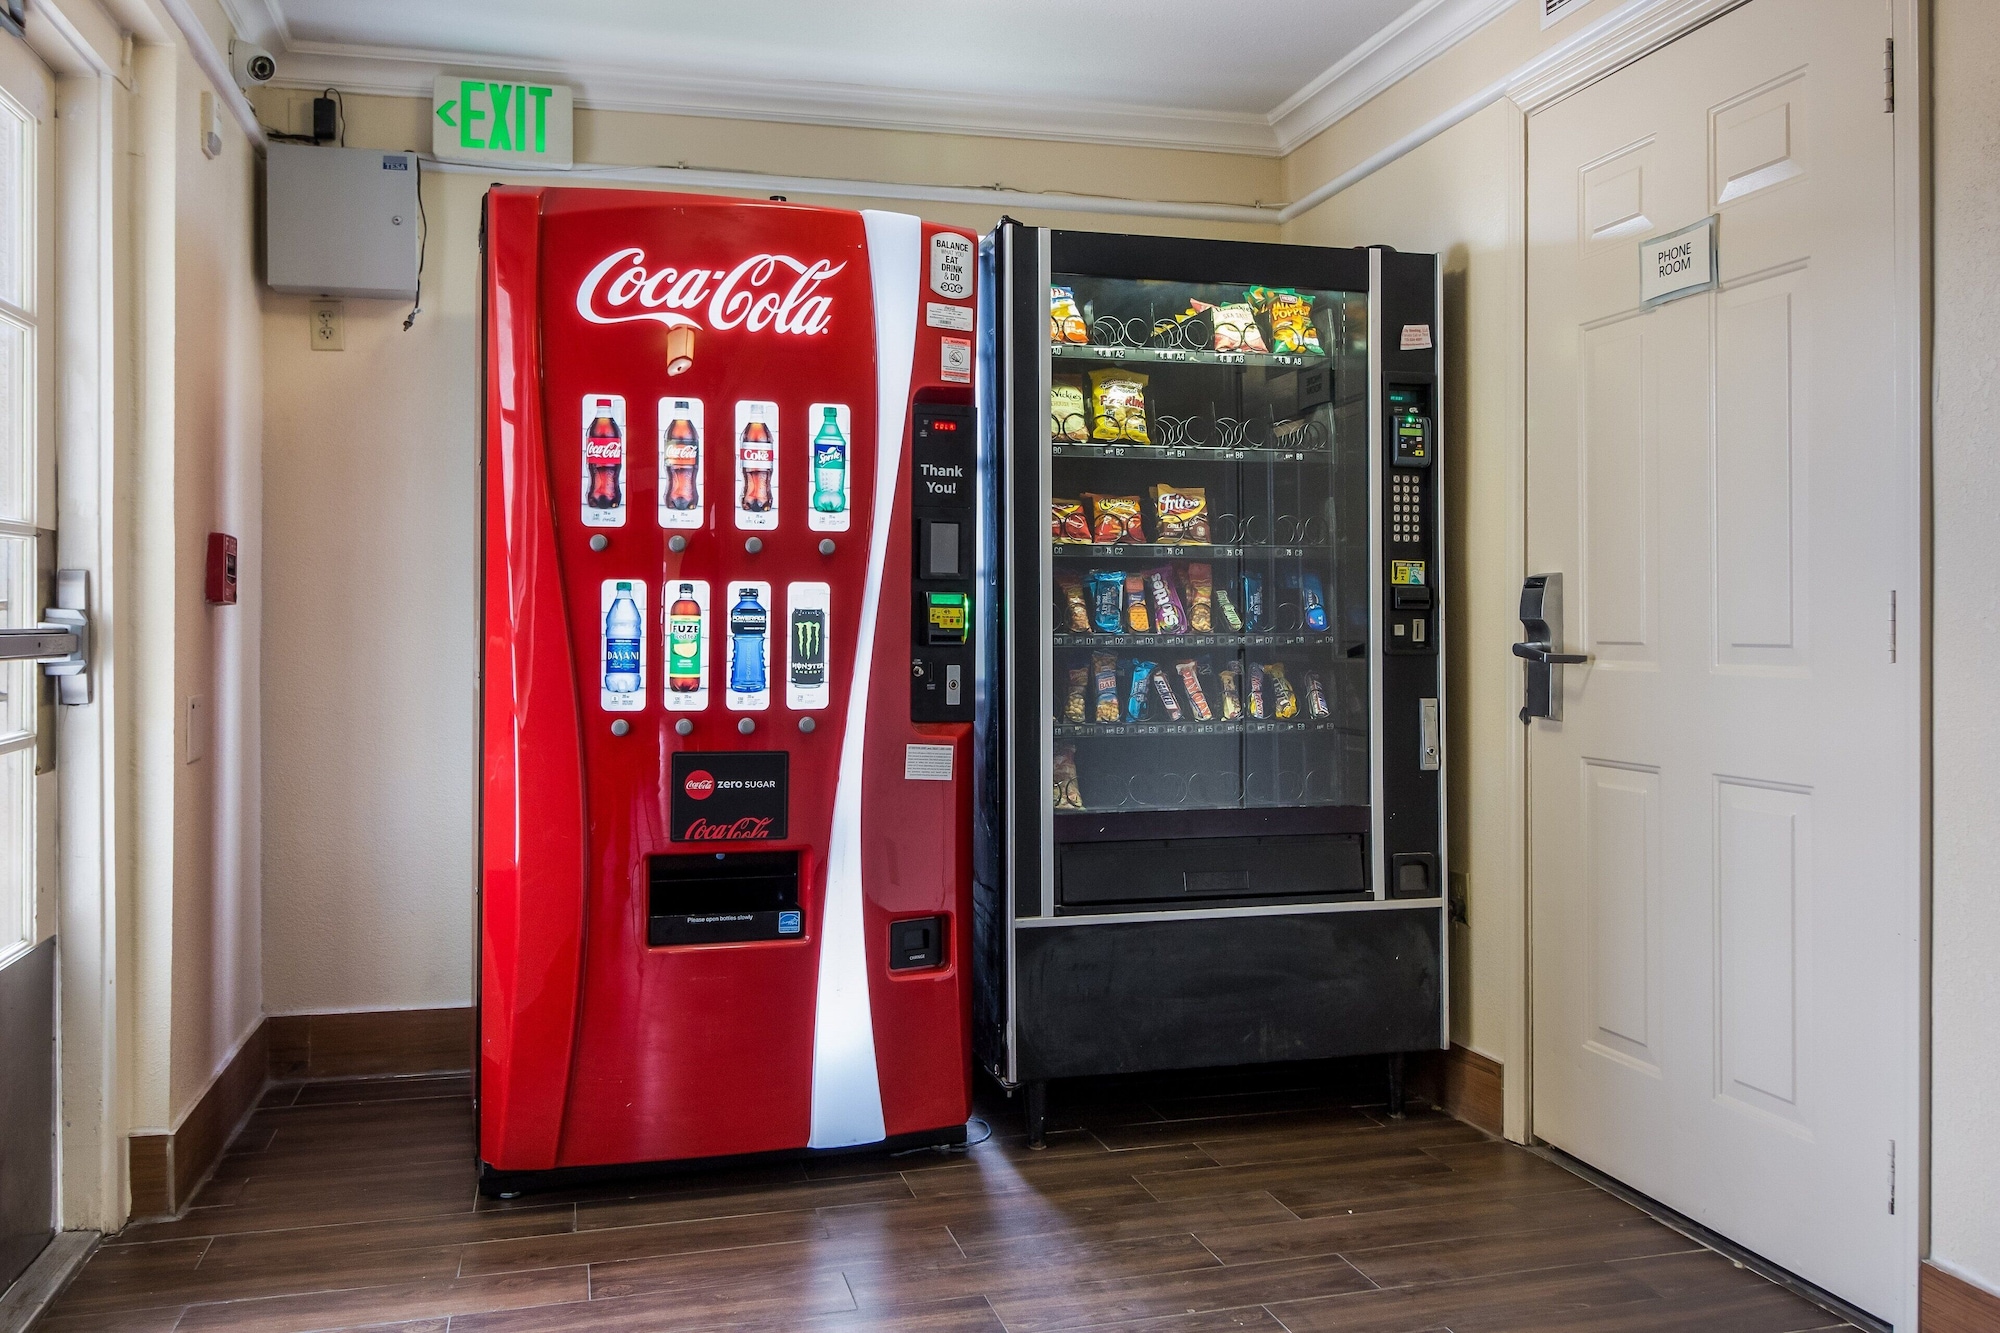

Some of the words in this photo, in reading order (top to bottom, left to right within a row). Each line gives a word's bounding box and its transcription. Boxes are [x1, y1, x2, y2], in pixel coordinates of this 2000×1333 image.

[460, 81, 552, 153] EXIT
[384, 163, 407, 171] TESA
[936, 239, 969, 252] BALANCE
[1658, 242, 1692, 264] PHONE
[945, 256, 958, 265] EAT
[941, 263, 963, 274] DRINK
[1659, 257, 1691, 278] ROOM
[943, 273, 949, 281] &
[950, 273, 960, 282] DO
[576, 247, 847, 336] Coca-Cola
[1052, 347, 1062, 355] A0
[1115, 350, 1125, 358] A2
[586, 441, 621, 458] Coca-Cola
[665, 444, 698, 459] Coca-Cola
[1052, 447, 1062, 455] B0
[1115, 448, 1125, 456] B2
[1177, 450, 1186, 458] B4
[743, 449, 769, 461] Coke
[818, 452, 841, 464] Sprite
[920, 464, 963, 477] Thank
[926, 481, 957, 494] You!
[1158, 493, 1200, 514] Fritos
[1115, 548, 1124, 556] C2
[1175, 548, 1184, 556] C4
[1294, 549, 1303, 557] C8
[673, 624, 699, 634] FUZE
[1053, 637, 1063, 645] D0
[1086, 637, 1094, 645] D1
[1115, 637, 1124, 645] D2
[1145, 637, 1154, 645] D3
[1175, 637, 1184, 645] D4
[1205, 637, 1215, 645] D5
[1237, 636, 1246, 644] D6
[1264, 636, 1274, 644] D7
[607, 651, 639, 661] DASANI
[791, 662, 824, 671] MONSTER
[1099, 680, 1116, 690] BAR
[1148, 726, 1157, 734] E3
[1205, 725, 1213, 733] E5
[685, 780, 713, 790] Coca-Cola
[717, 780, 743, 789] zero
[744, 780, 776, 789] SUGAR
[684, 817, 774, 840] Coca-Cola
